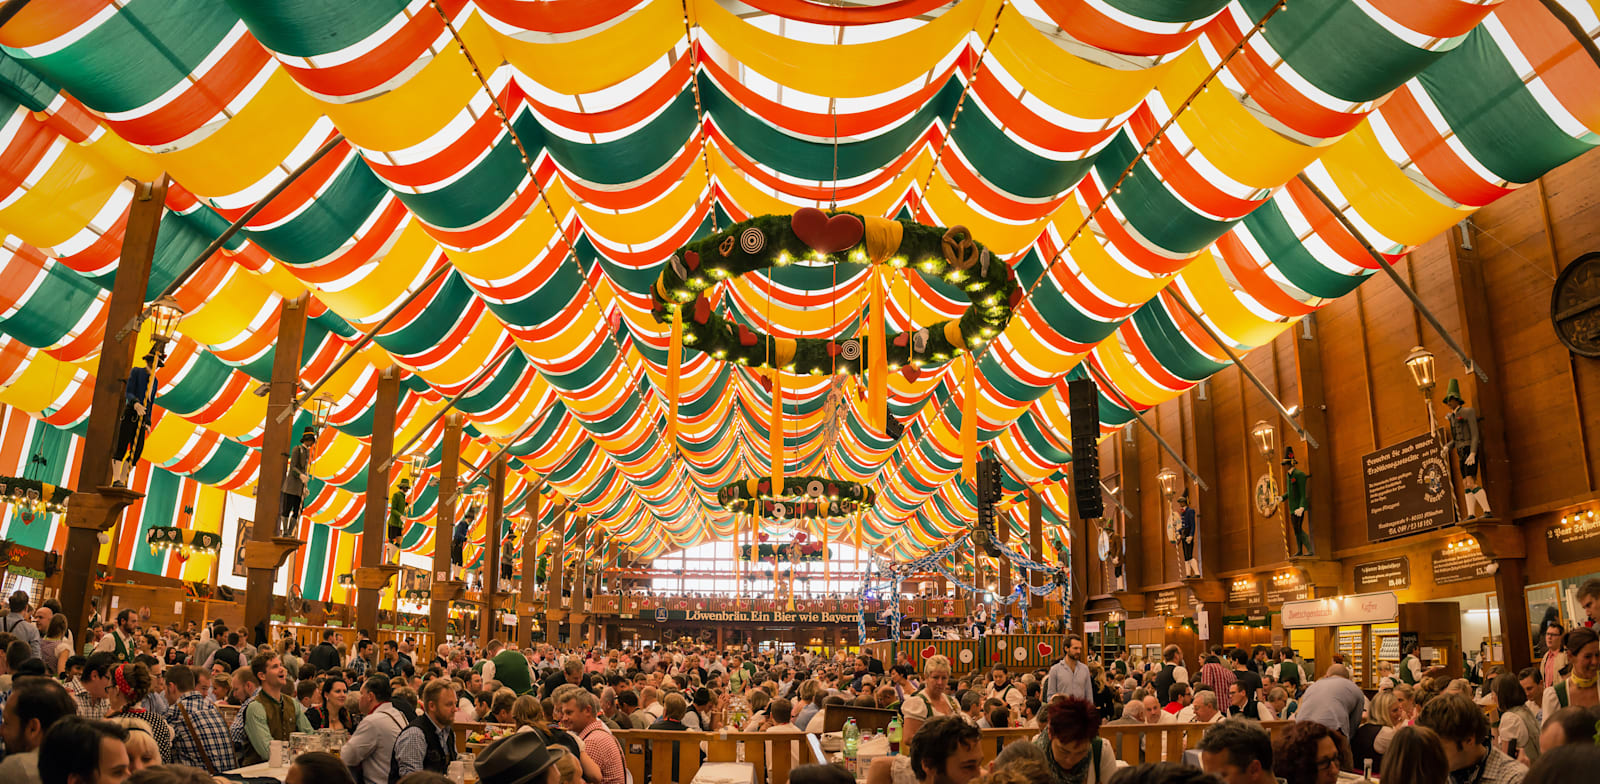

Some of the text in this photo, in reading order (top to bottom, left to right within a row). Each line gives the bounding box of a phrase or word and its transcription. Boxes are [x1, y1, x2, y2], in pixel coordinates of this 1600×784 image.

[685, 609, 859, 624] Löwenbräu. Ein Bier wie Bayern
